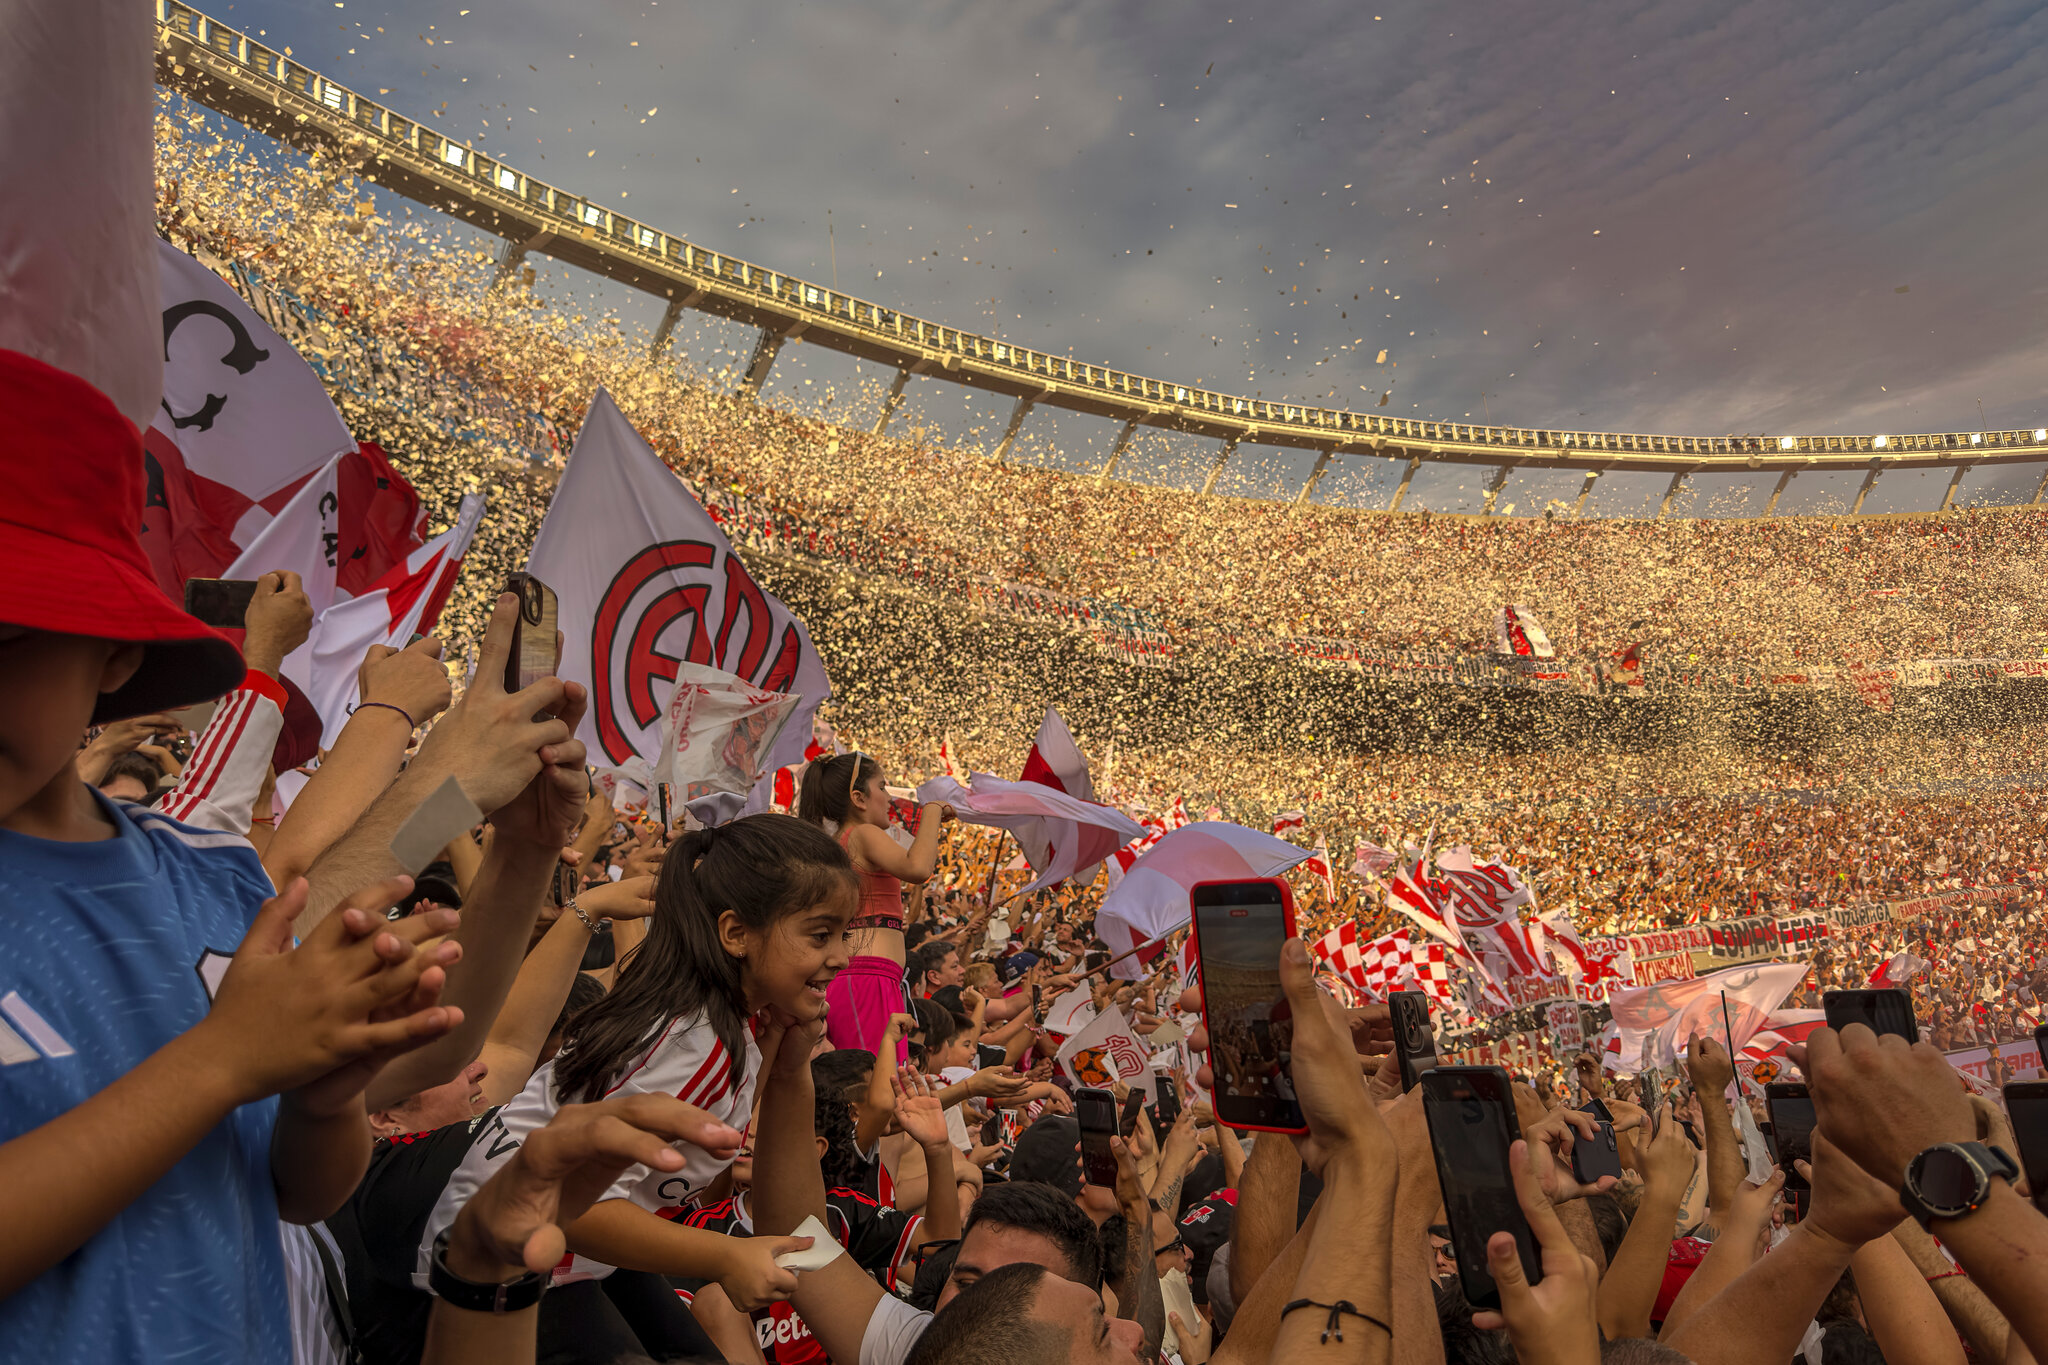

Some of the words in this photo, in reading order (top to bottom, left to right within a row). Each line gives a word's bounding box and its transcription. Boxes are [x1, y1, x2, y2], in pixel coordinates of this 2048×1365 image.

[1584, 937, 1628, 957] RCELO
[1643, 926, 1712, 955] PEREYRA
[1708, 915, 1779, 958] LOMAS
